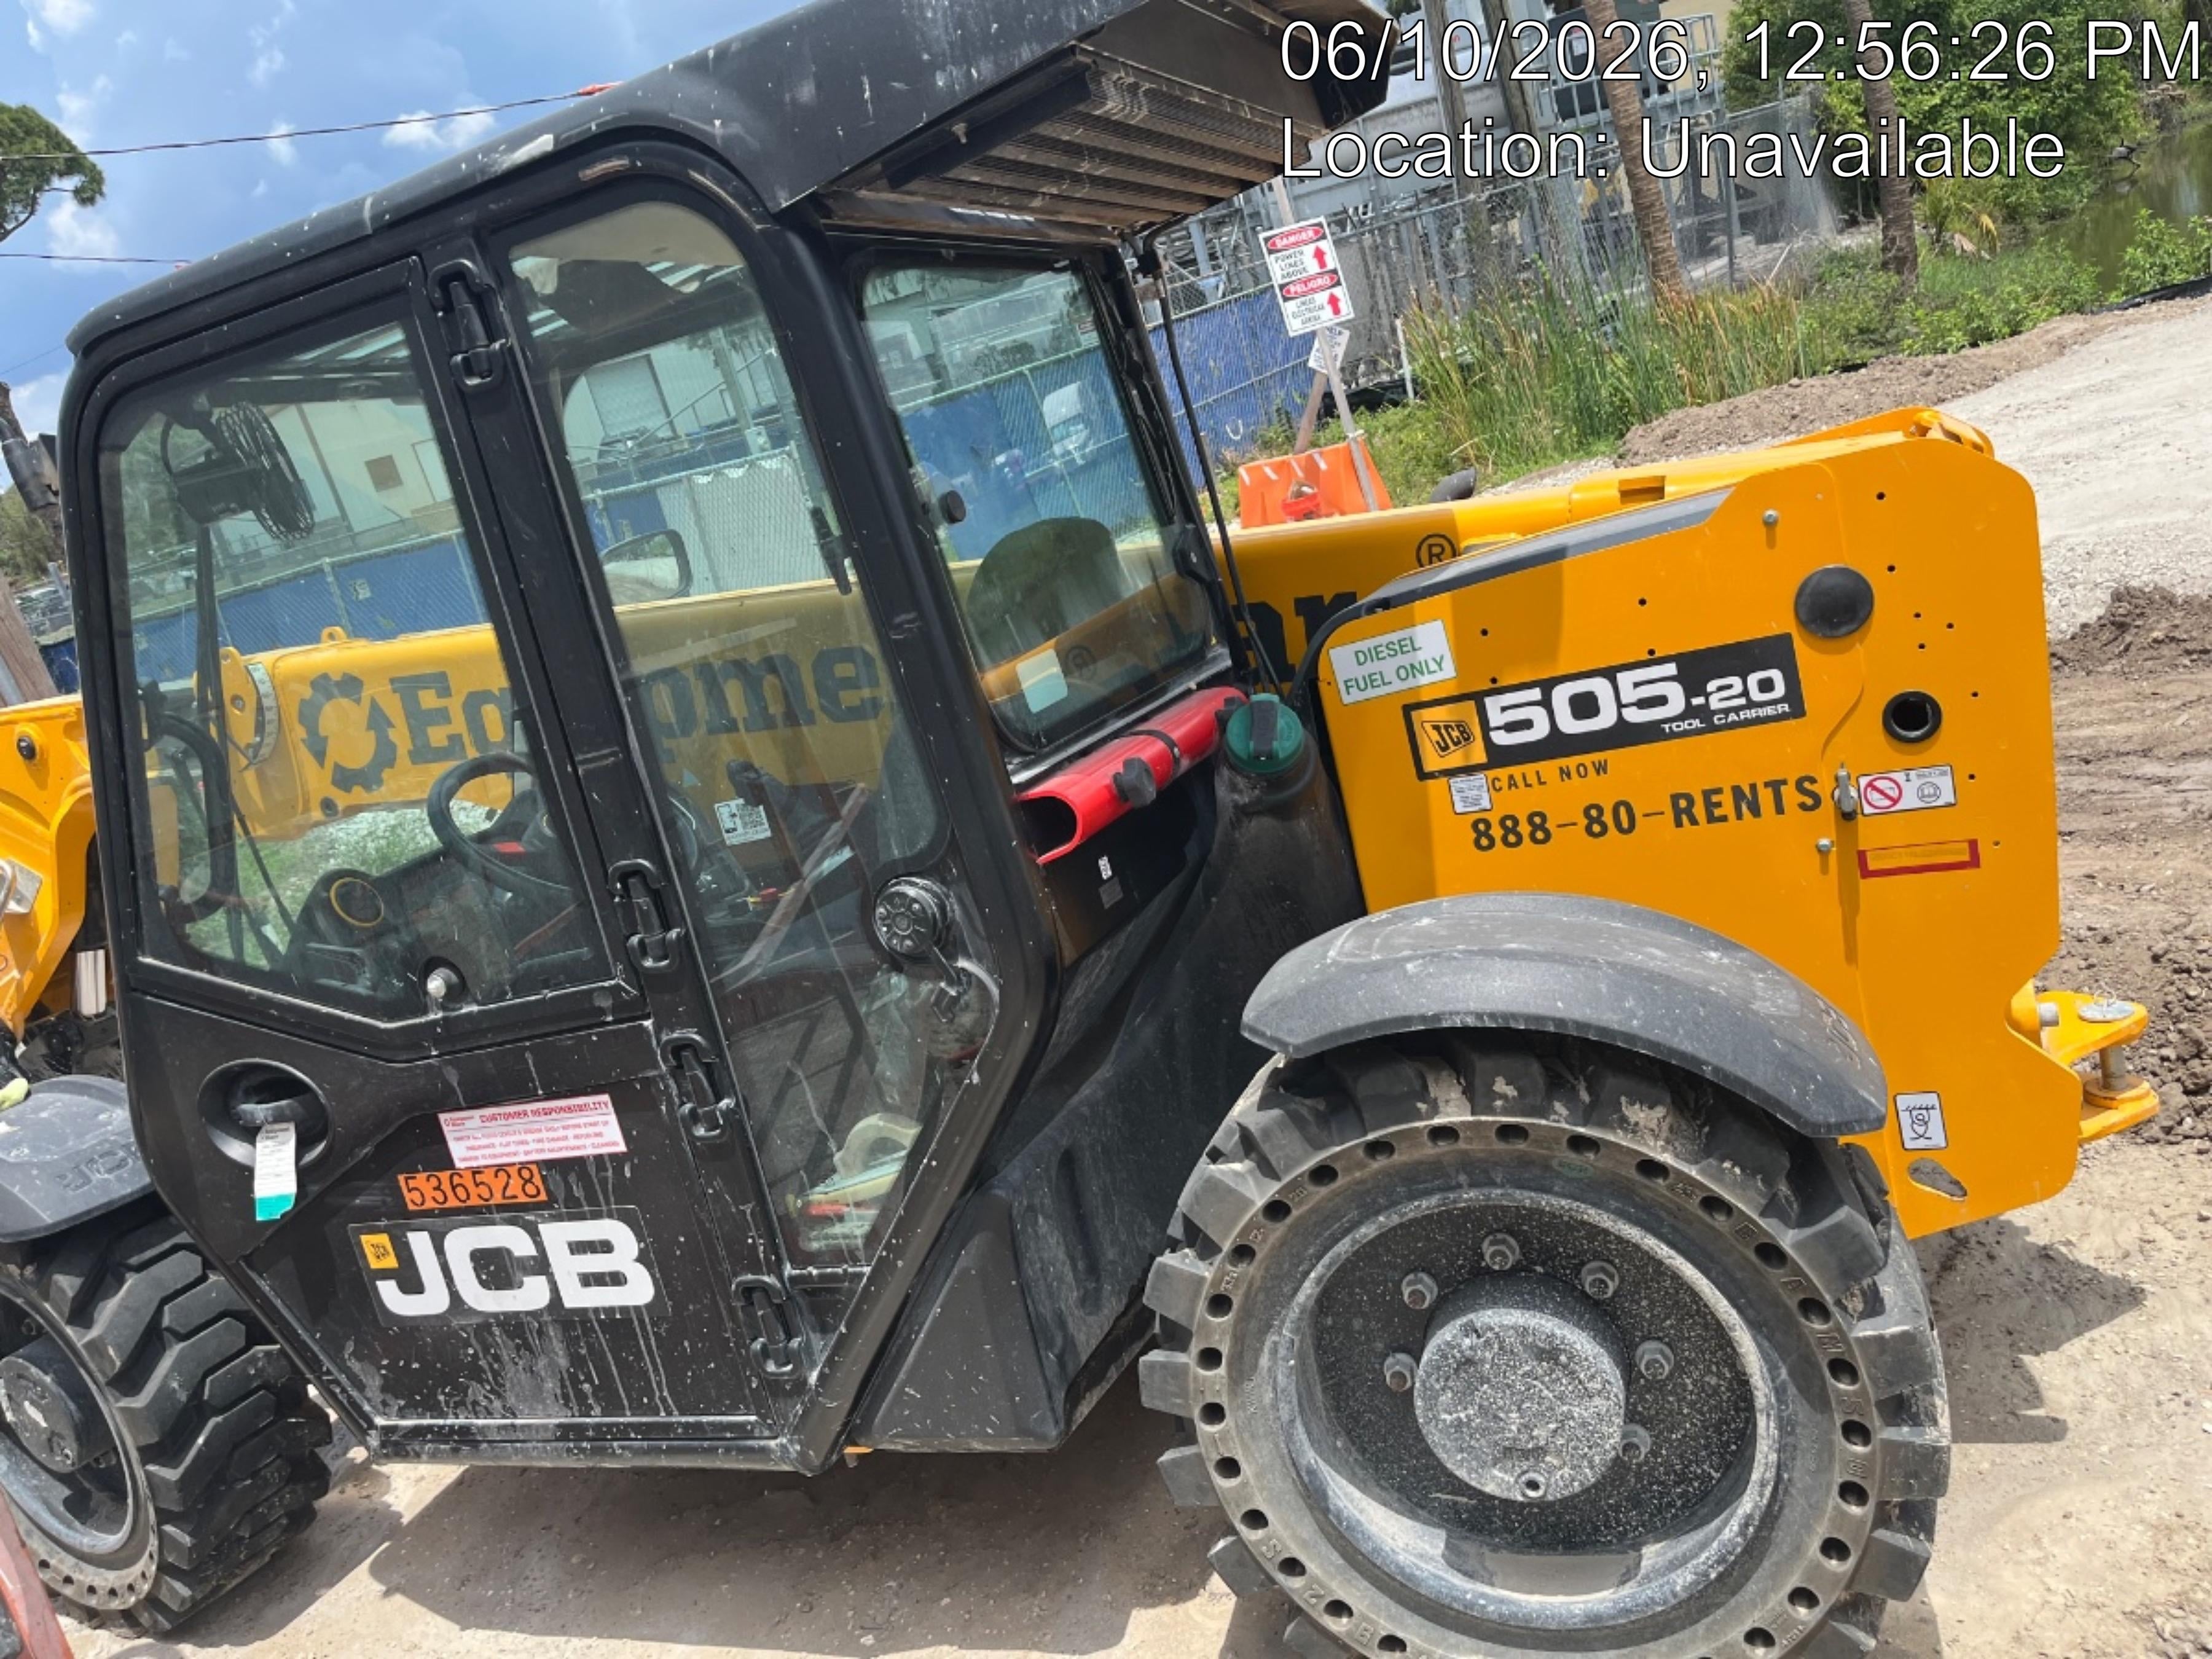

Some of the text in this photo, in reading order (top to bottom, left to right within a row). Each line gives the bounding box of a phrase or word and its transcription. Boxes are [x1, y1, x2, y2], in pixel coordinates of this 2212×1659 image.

[1274, 229, 1316, 246] DANGER
[1275, 249, 1304, 264] POWER
[1279, 258, 1304, 272] LINES
[1289, 275, 1330, 292] PELIGRO
[1354, 635, 1422, 667] DIESEL
[1343, 654, 1445, 696] FUEL ONLY
[1430, 662, 1785, 753] JCB 505-20
[1660, 703, 1790, 734] TOOL CARRIER
[1492, 770, 1548, 793] CALL
[1559, 758, 1610, 782] NOW
[1472, 775, 1822, 853] 888-80-RENTS
[479, 1108, 530, 1124] CUSTOMER
[530, 1100, 609, 1119] RESPONSIBILITY
[404, 1166, 541, 1207] 536528
[375, 1218, 655, 1316] JCB
